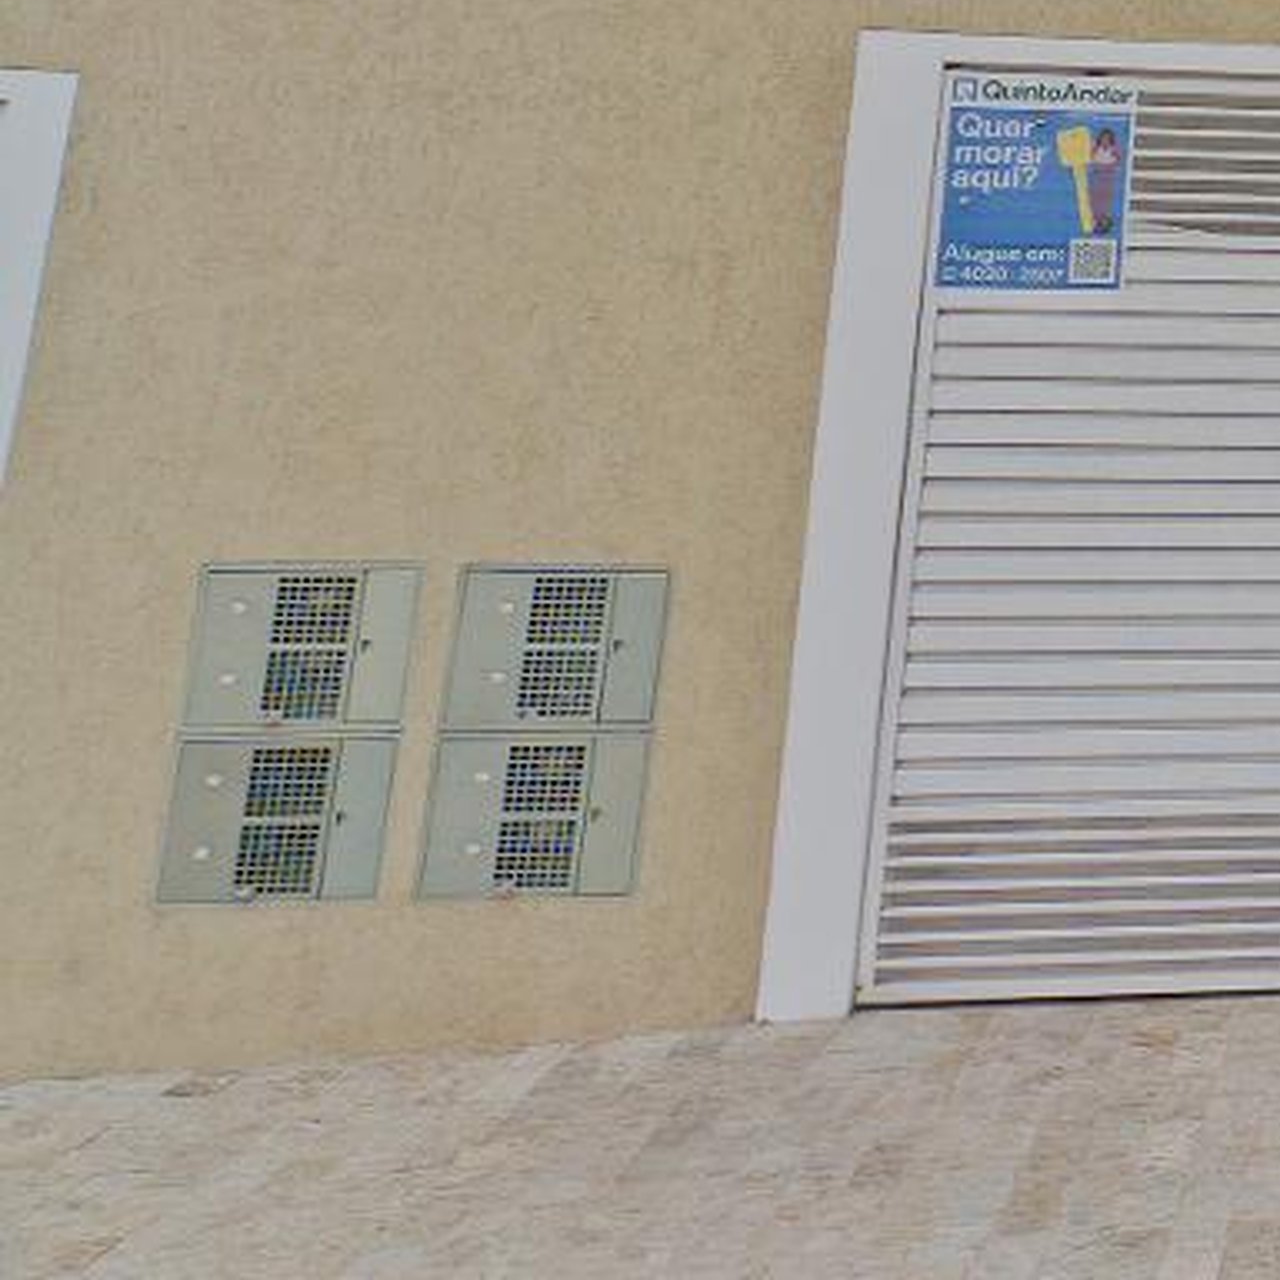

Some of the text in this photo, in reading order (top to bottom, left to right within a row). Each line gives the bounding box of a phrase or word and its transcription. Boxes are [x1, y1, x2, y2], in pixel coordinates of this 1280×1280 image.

[981, 79, 1133, 105] QuintoAndar
[955, 145, 1043, 164] morar
[950, 166, 1038, 194] aqui?
